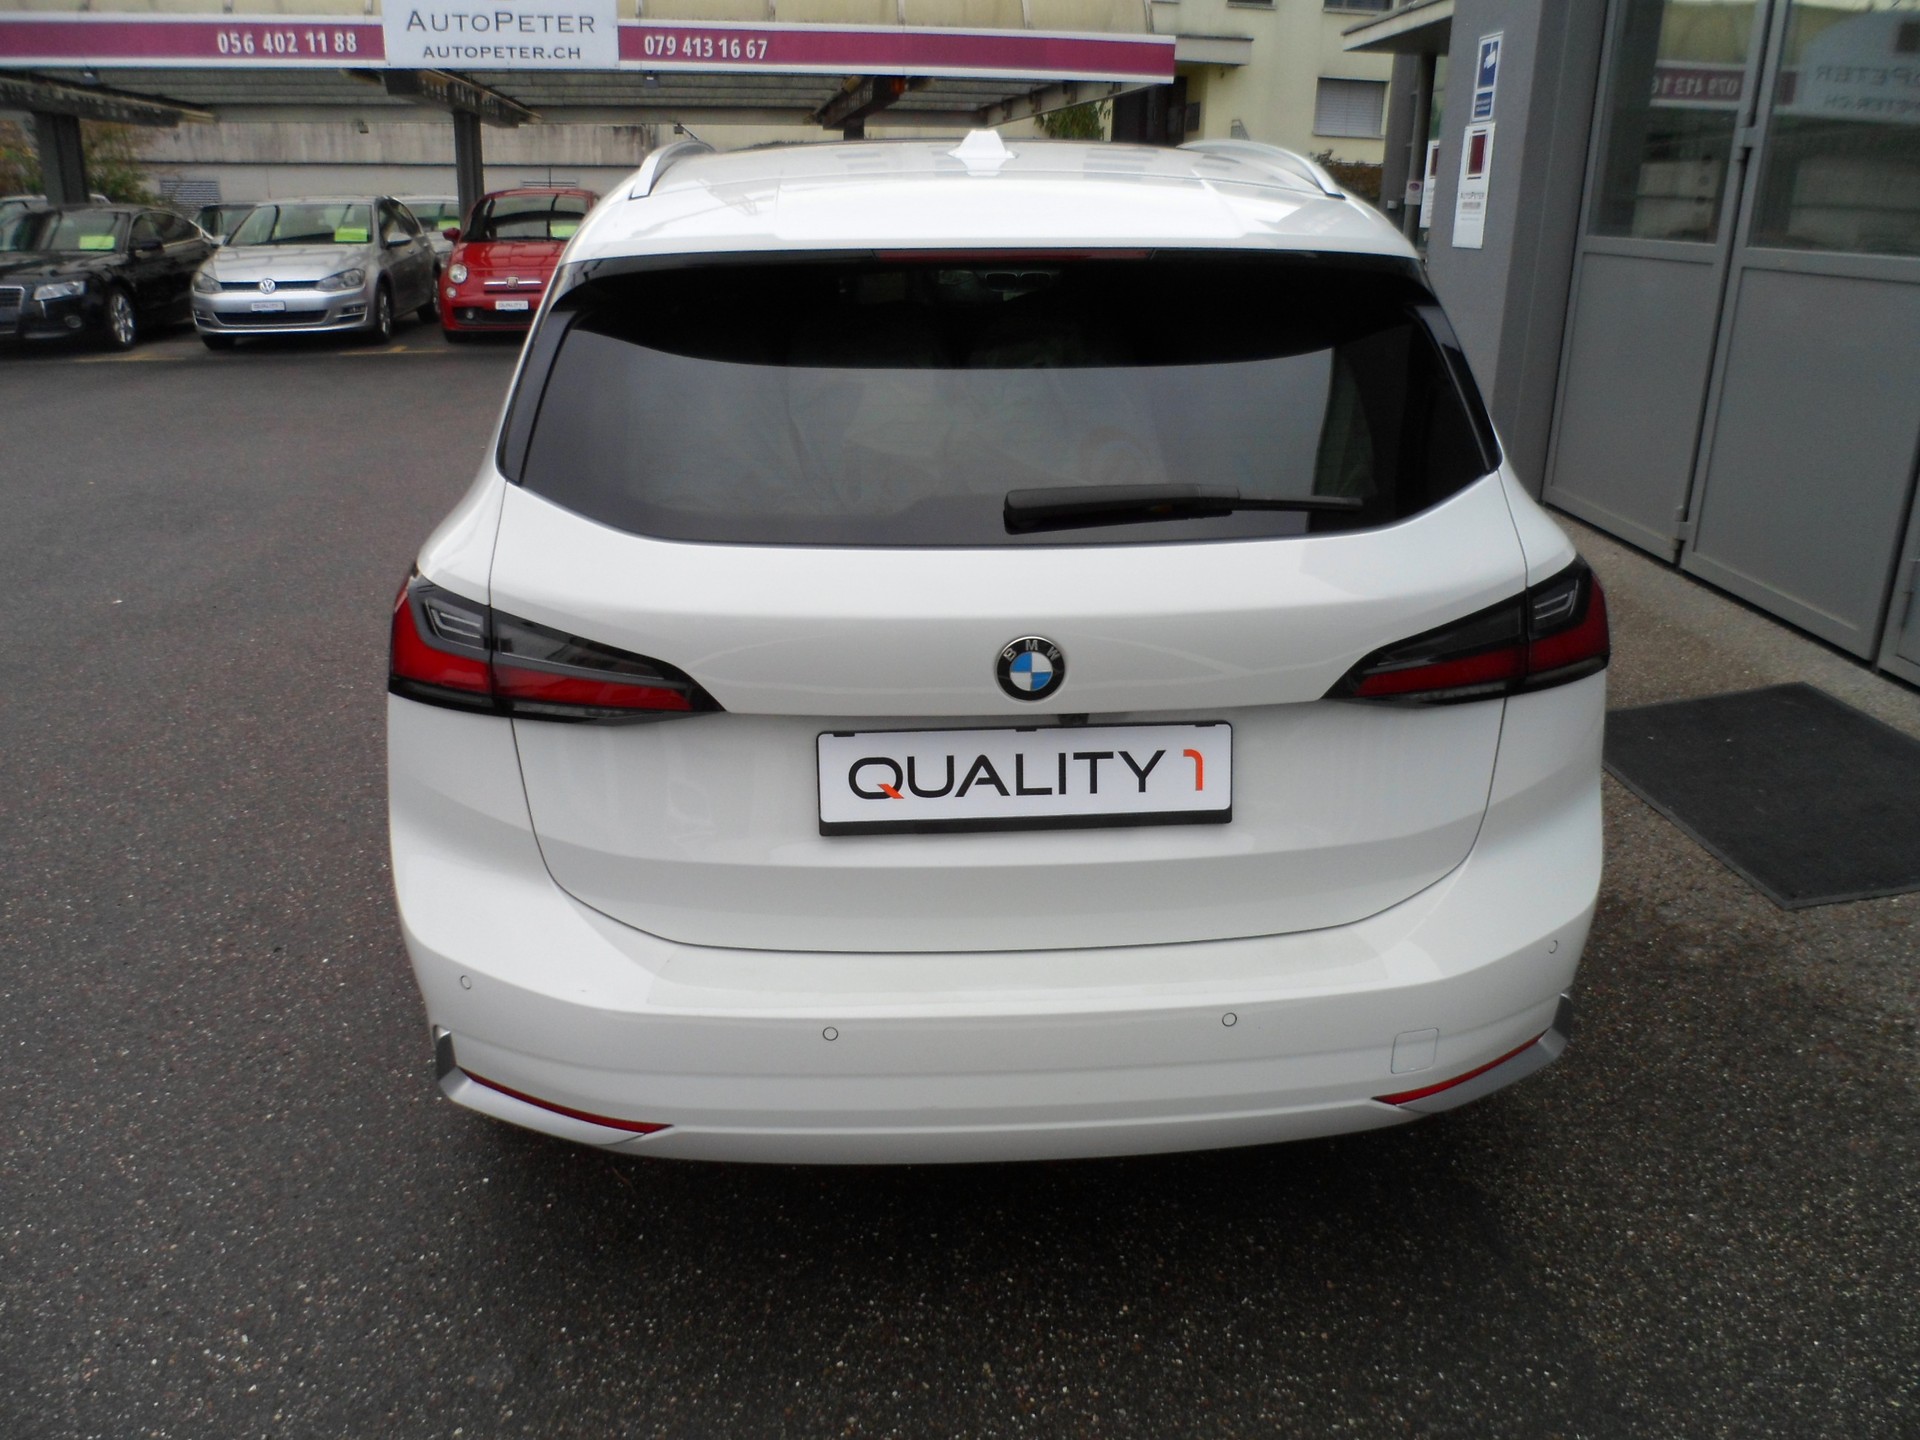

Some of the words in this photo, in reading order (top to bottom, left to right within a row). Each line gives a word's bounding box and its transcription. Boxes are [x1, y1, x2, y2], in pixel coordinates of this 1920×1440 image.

[217, 32, 255, 54] 056
[263, 31, 299, 53] 402
[305, 32, 327, 53] 11
[334, 32, 357, 53] 88
[422, 45, 582, 60] AUTOPETER.CH
[644, 35, 677, 56] 079
[682, 37, 714, 58] 413
[718, 39, 741, 58] 16
[746, 39, 768, 59] 67
[1003, 639, 1060, 661] BMW
[848, 750, 1166, 800] QUALITY
[1183, 748, 1203, 791] 1
